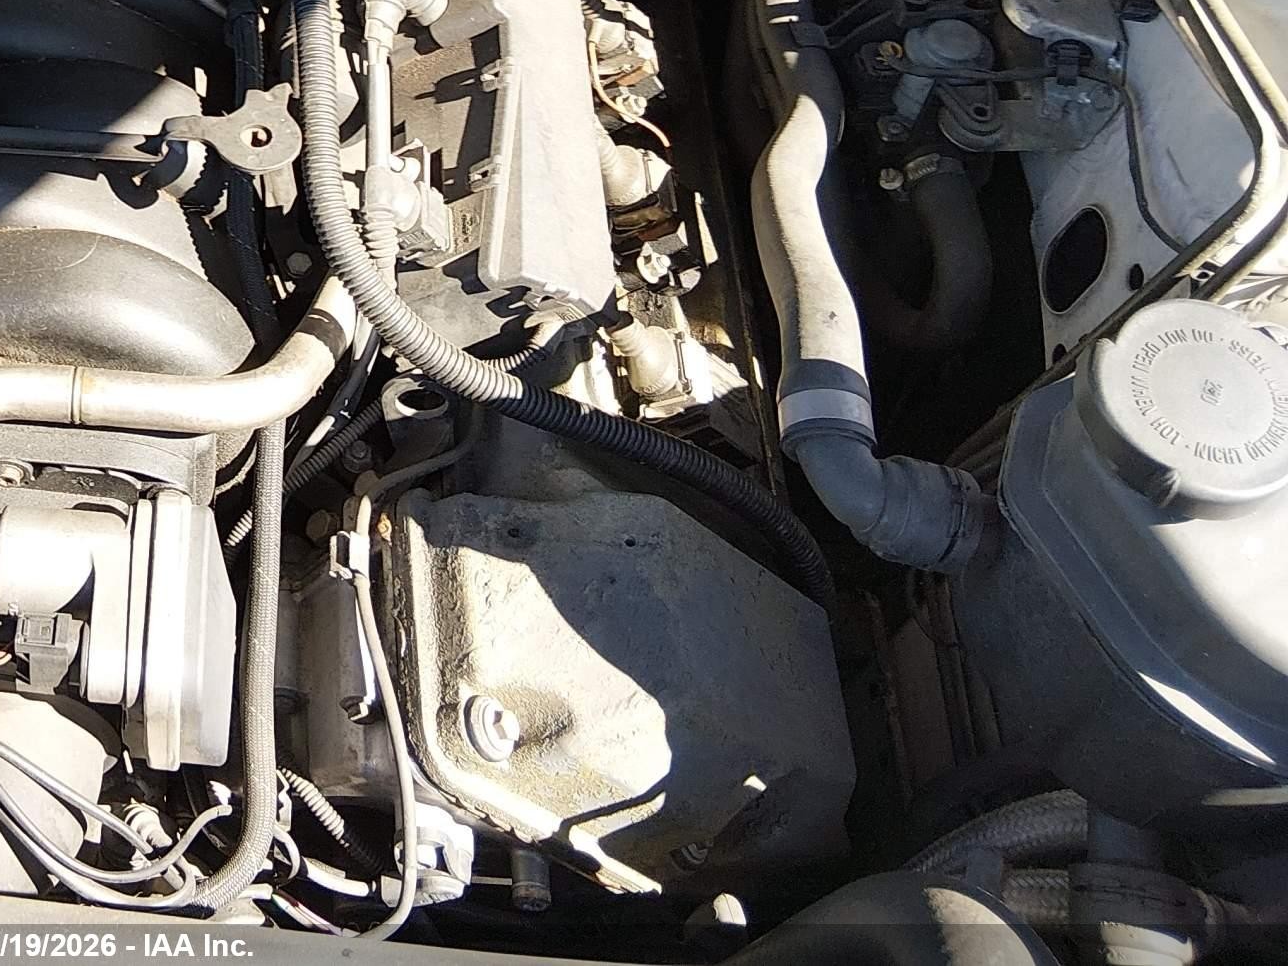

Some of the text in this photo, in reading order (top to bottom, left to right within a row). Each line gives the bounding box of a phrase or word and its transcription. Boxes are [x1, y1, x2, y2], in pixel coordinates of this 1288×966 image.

[1131, 328, 1213, 446] DO NOT OPEN WHEN HOT
[1194, 441, 1243, 465] NICHT
